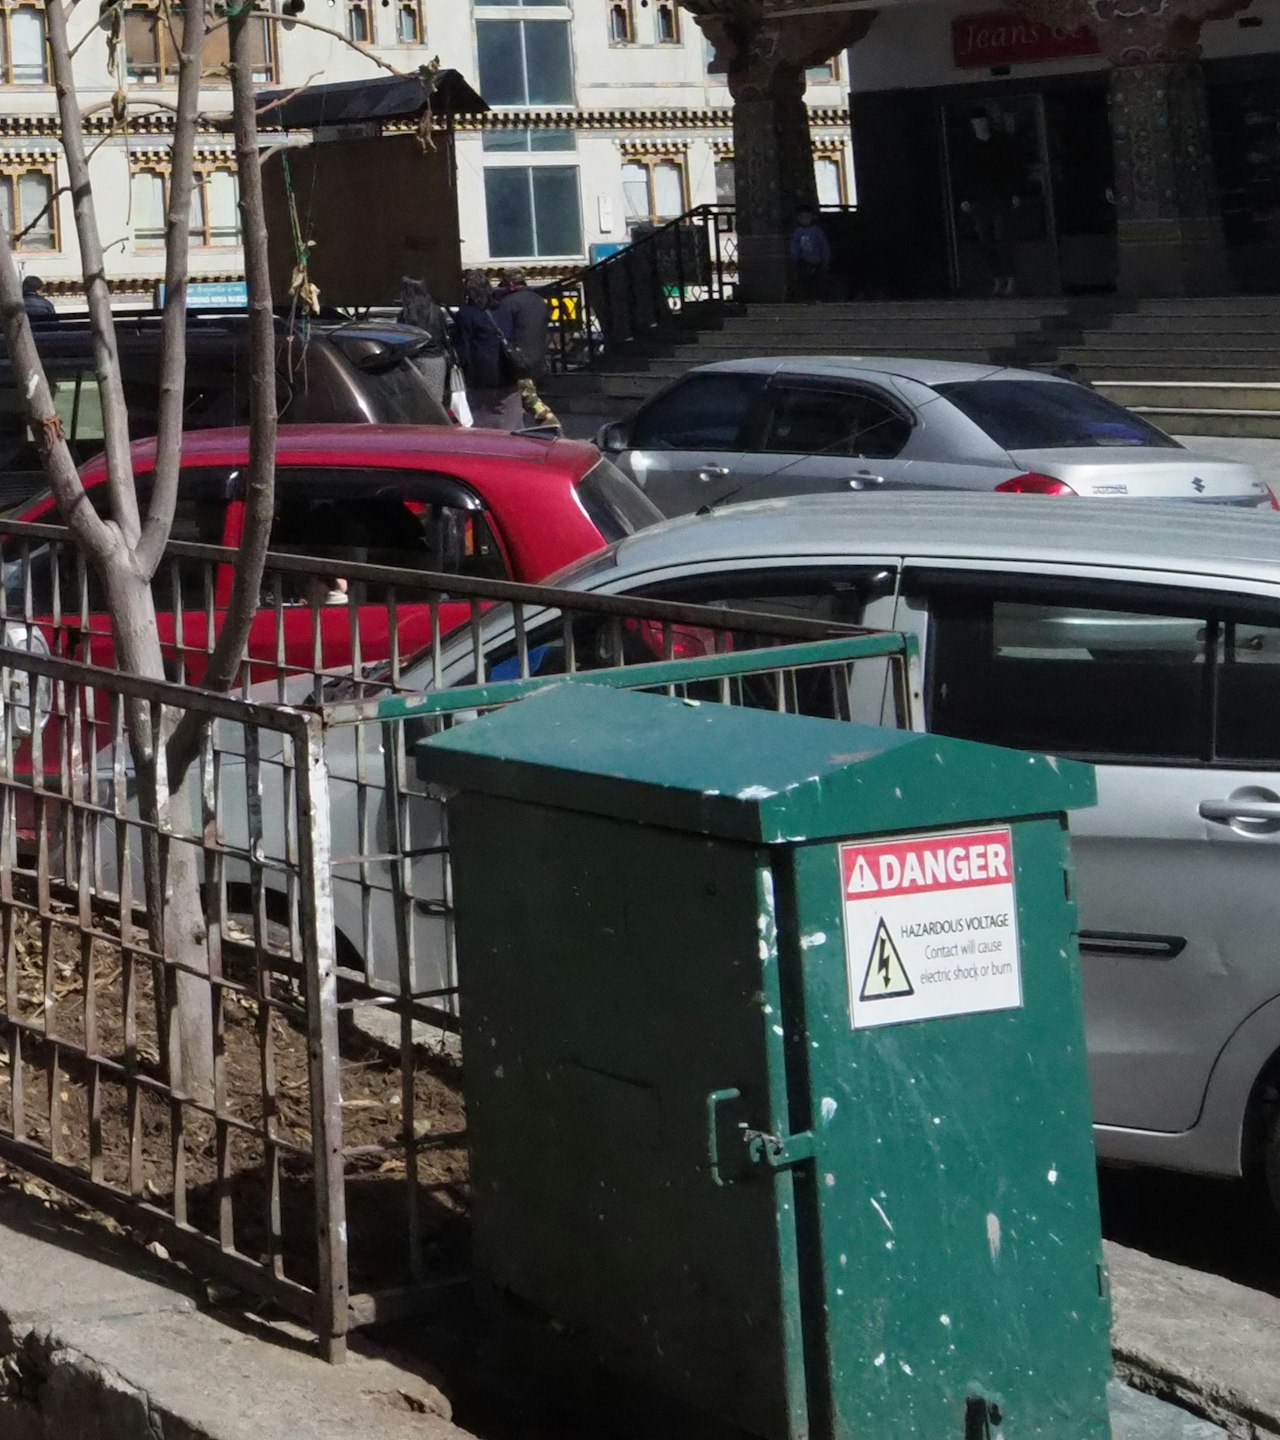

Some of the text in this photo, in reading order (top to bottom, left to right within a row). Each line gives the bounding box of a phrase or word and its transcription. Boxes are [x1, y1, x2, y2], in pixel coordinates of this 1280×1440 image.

[878, 843, 1009, 890] DANGER
[900, 913, 1010, 939] HAZARDOUS VOLTAGE
[924, 939, 1003, 960] Contact will cause
[920, 962, 1013, 985] electric shock or burn
